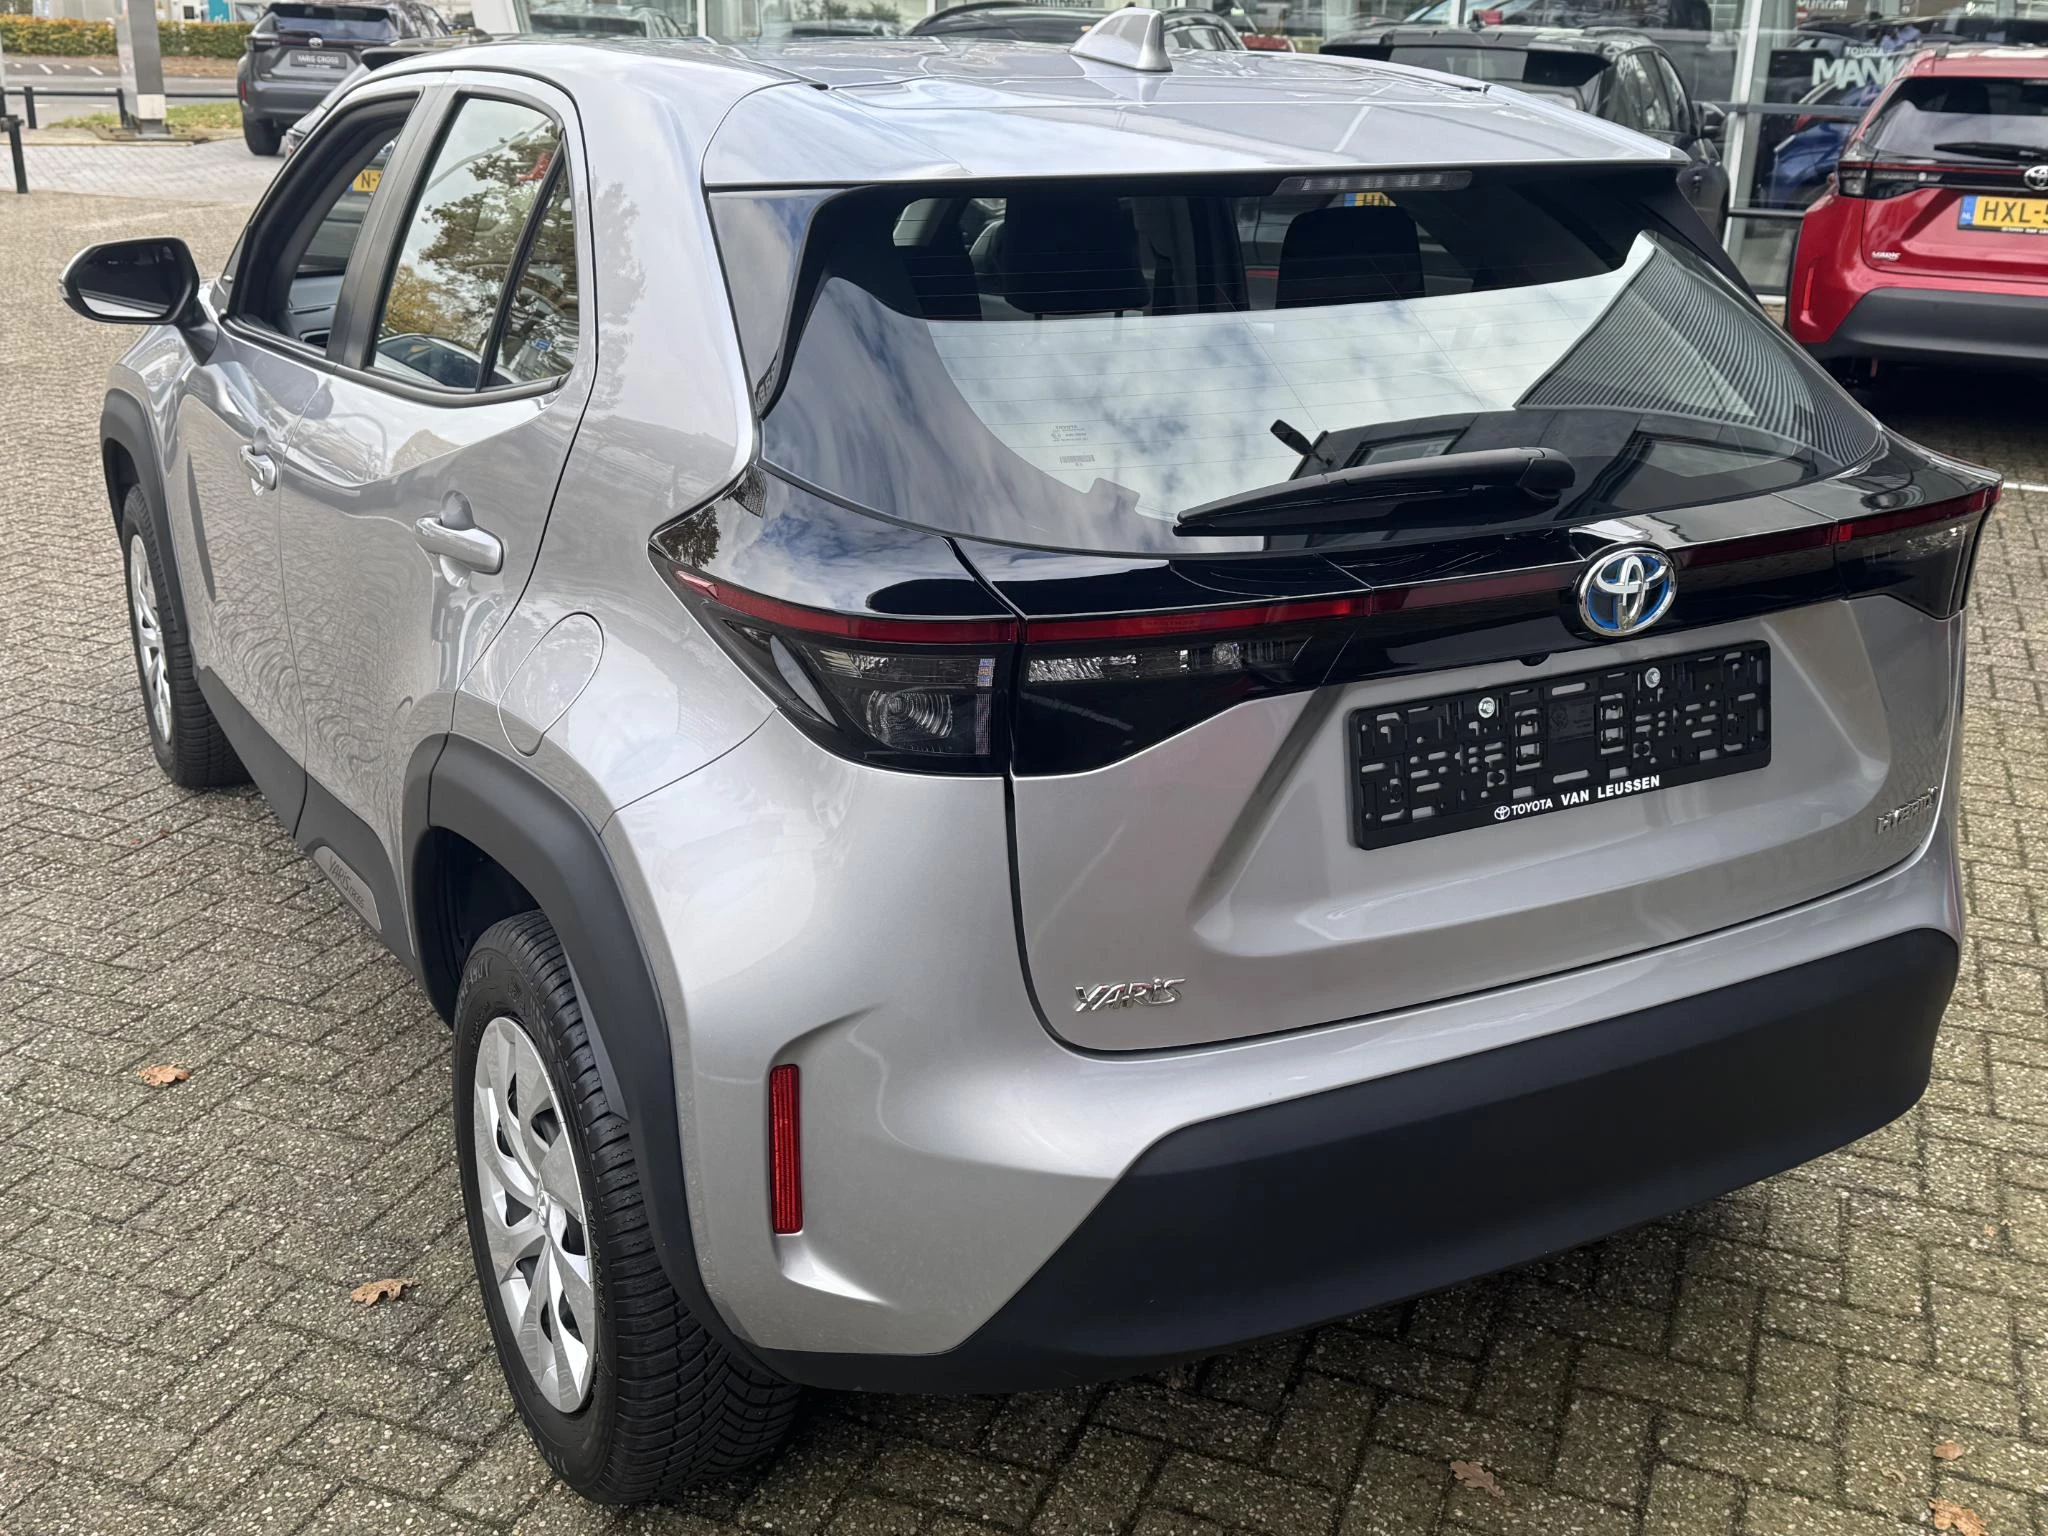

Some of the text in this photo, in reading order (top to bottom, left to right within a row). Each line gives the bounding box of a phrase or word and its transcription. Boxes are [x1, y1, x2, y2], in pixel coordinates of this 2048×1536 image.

[1511, 774, 1660, 816] TOYOTA VAN LEUSSEN
[1075, 977, 1186, 1013] YARIS
